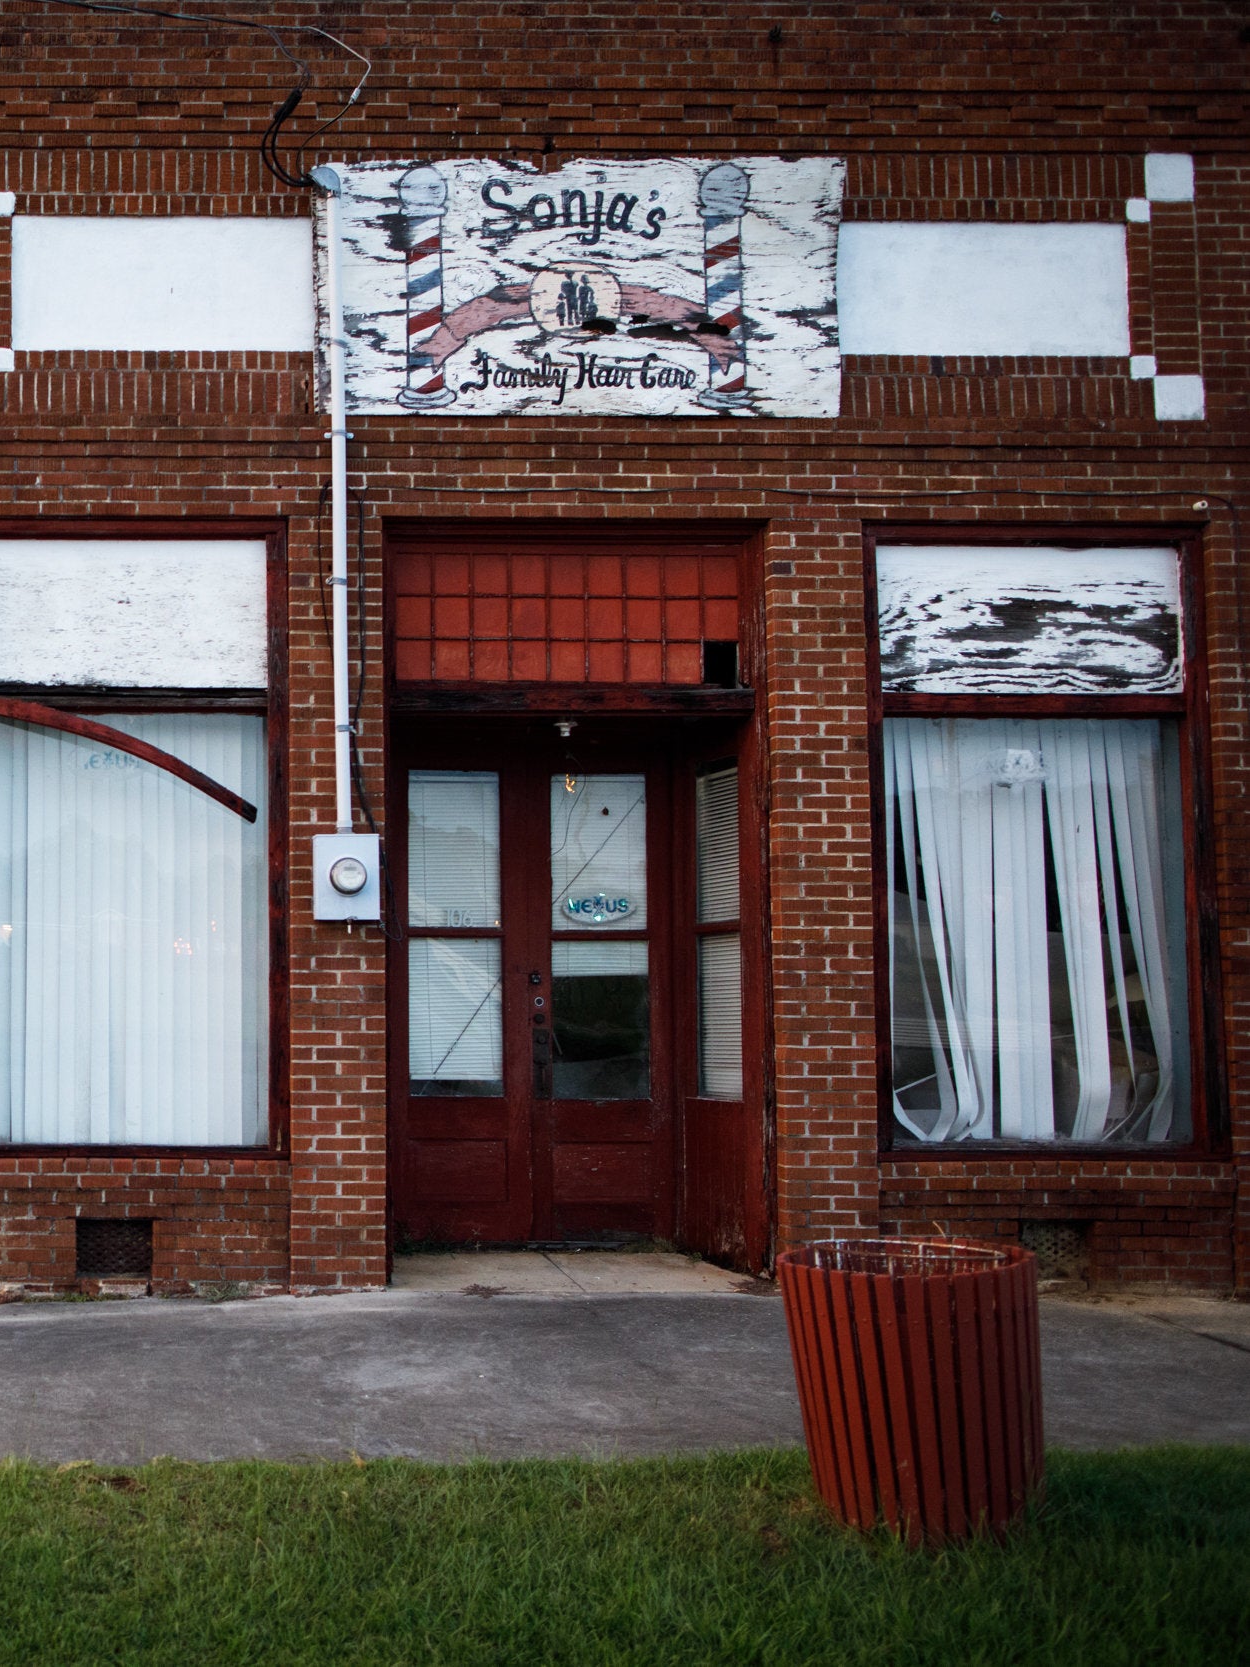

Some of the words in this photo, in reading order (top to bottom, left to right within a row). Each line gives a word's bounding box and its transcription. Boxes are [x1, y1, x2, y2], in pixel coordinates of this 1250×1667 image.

[481, 178, 667, 245] Sonja's
[459, 349, 568, 405] Family
[573, 352, 635, 390] Hair
[639, 352, 697, 390] Care
[446, 908, 474, 927] 106
[568, 896, 629, 914] NEXUS
